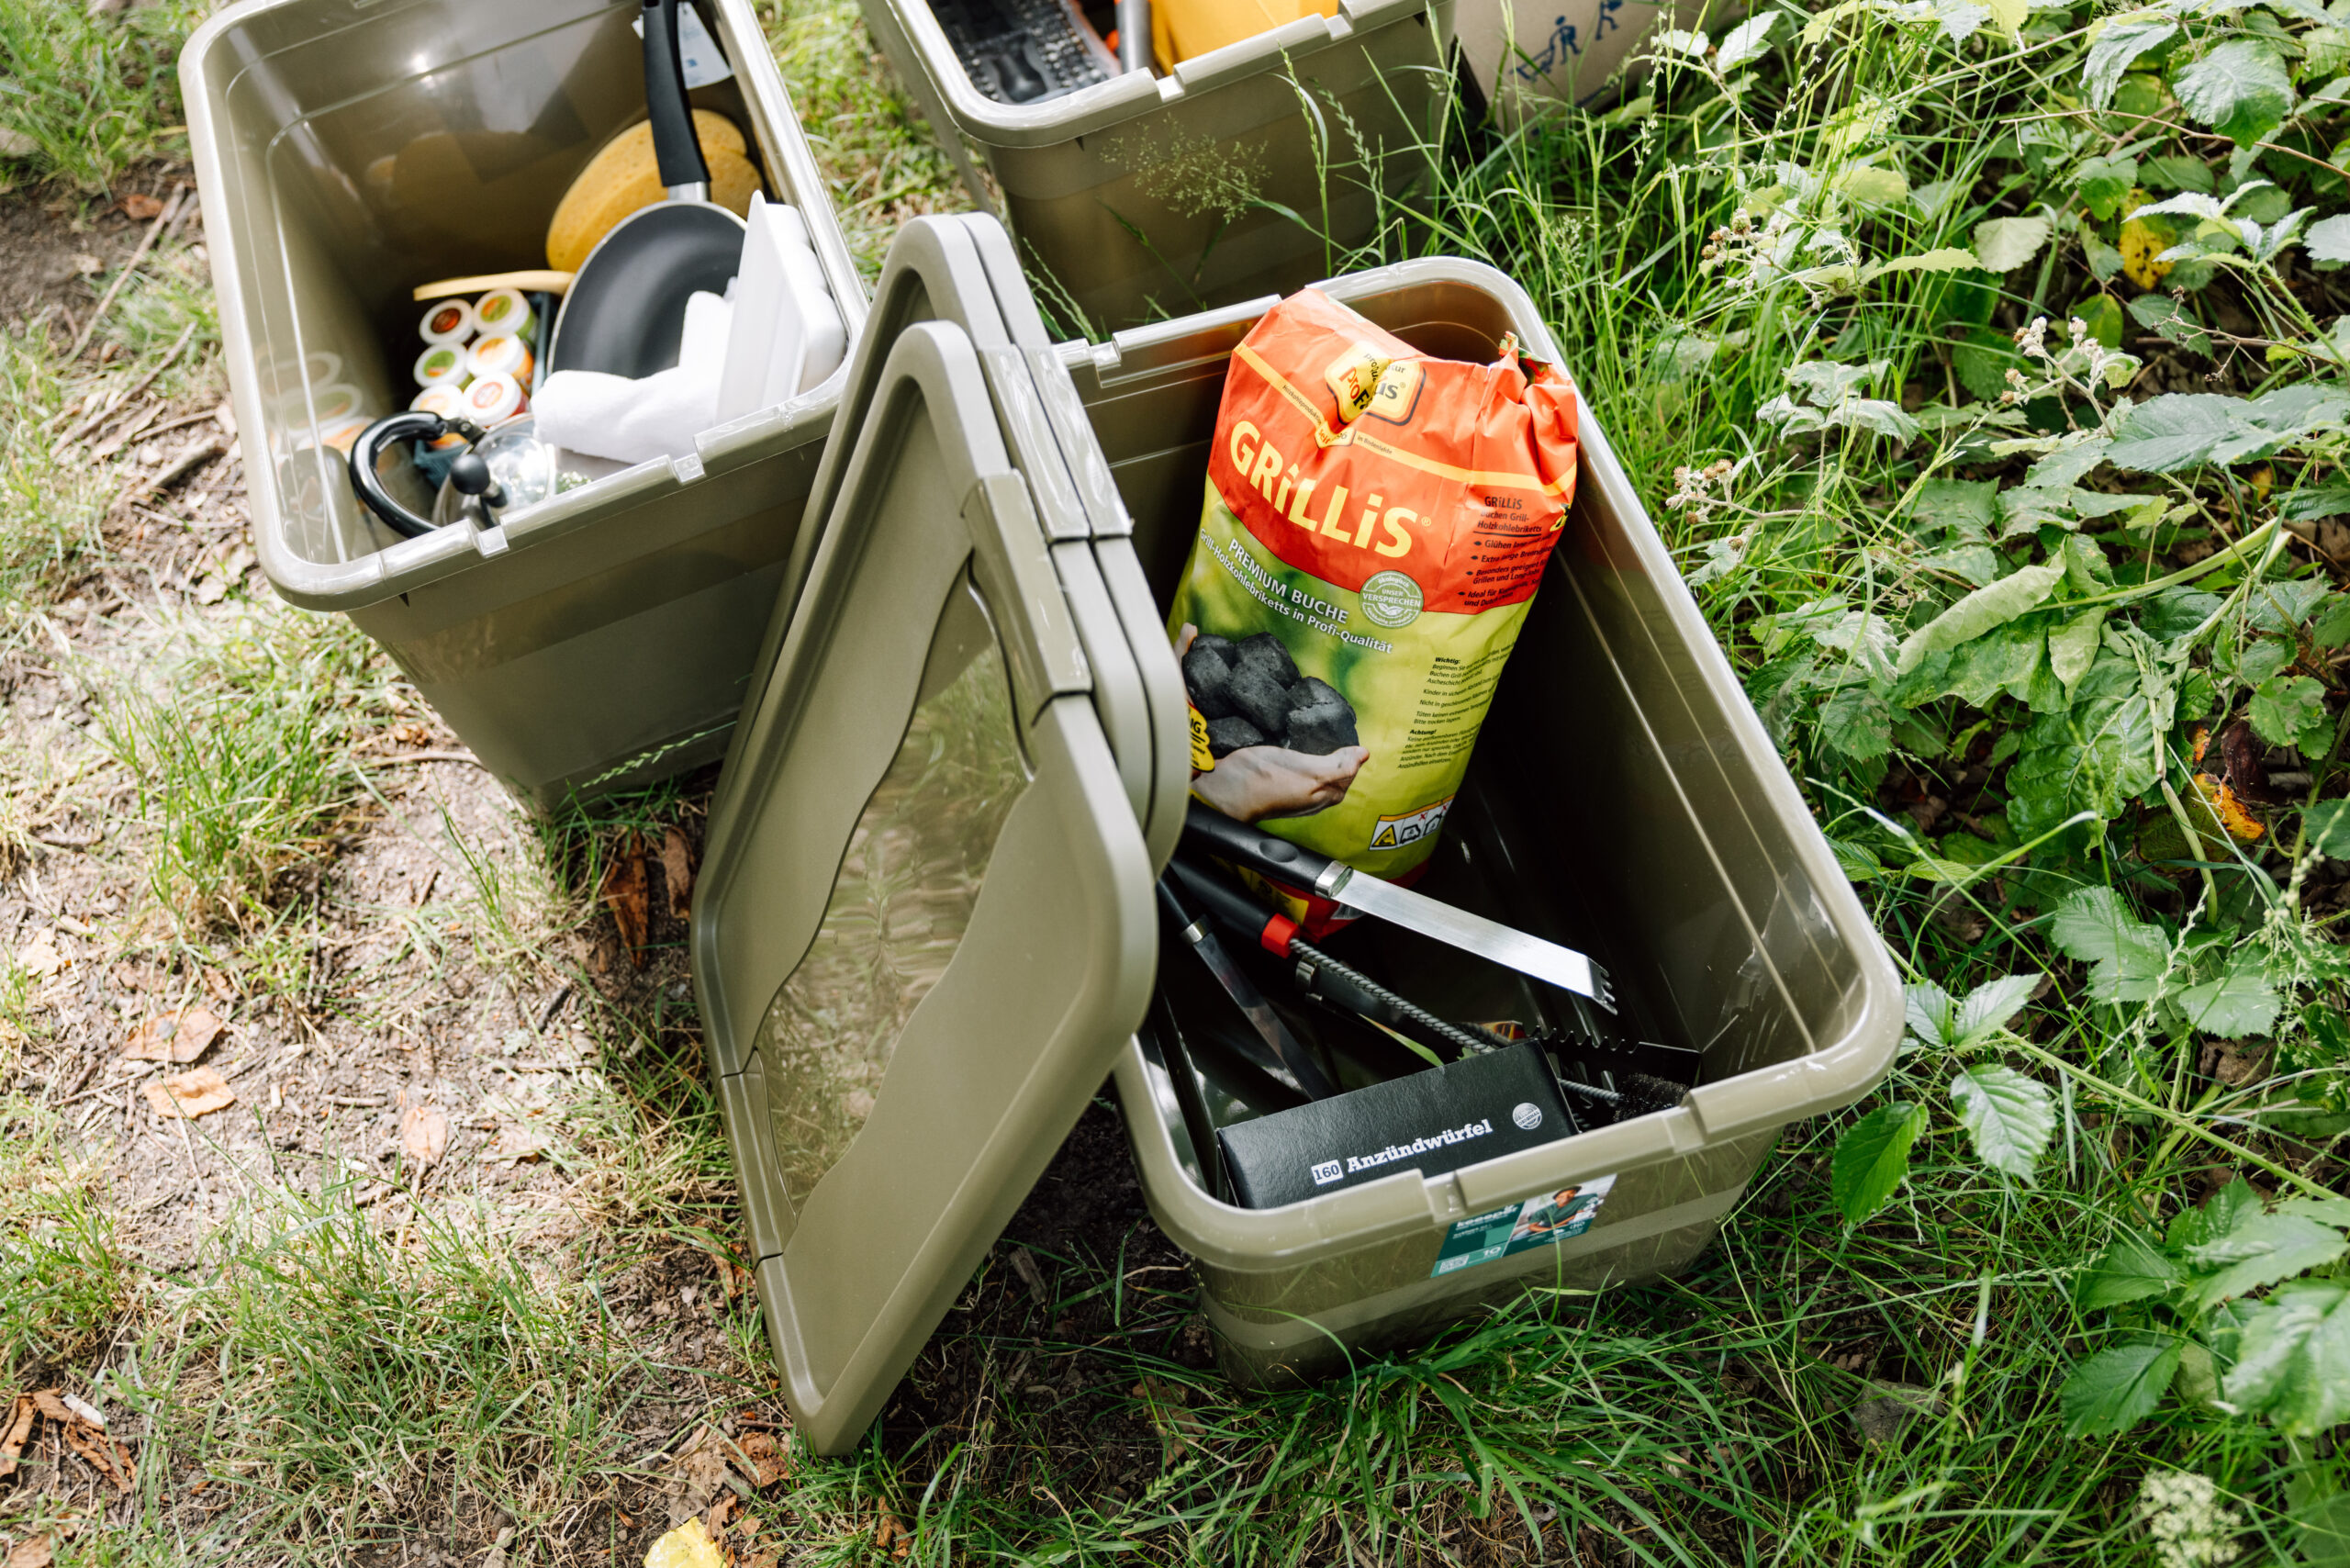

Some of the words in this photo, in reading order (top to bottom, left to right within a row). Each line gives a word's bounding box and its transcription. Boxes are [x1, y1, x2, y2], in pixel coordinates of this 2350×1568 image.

[1484, 496, 1522, 510] GRiLLiS
[1510, 512, 1529, 522] Grill-
[1477, 521, 1542, 532] Holzkohlebriketts
[1484, 540, 1511, 549] Glühen
[1228, 538, 1287, 597] PREMIUM
[1291, 589, 1348, 624] BUCHE
[1472, 576, 1495, 585] Grillen
[1496, 573, 1509, 581] und
[1200, 528, 1291, 615] Grill-Holzkohlebriketts
[1292, 608, 1304, 622] in
[1307, 616, 1393, 655] Profi-Qualität
[1382, 588, 1404, 597] UNSER
[1468, 588, 1485, 598] Ideal
[1362, 593, 1421, 608] VERSPRECHEN
[1435, 656, 1460, 665] Wichtig:
[1314, 1163, 1340, 1182] 160
[1346, 1119, 1494, 1174] Anzündwürfel
